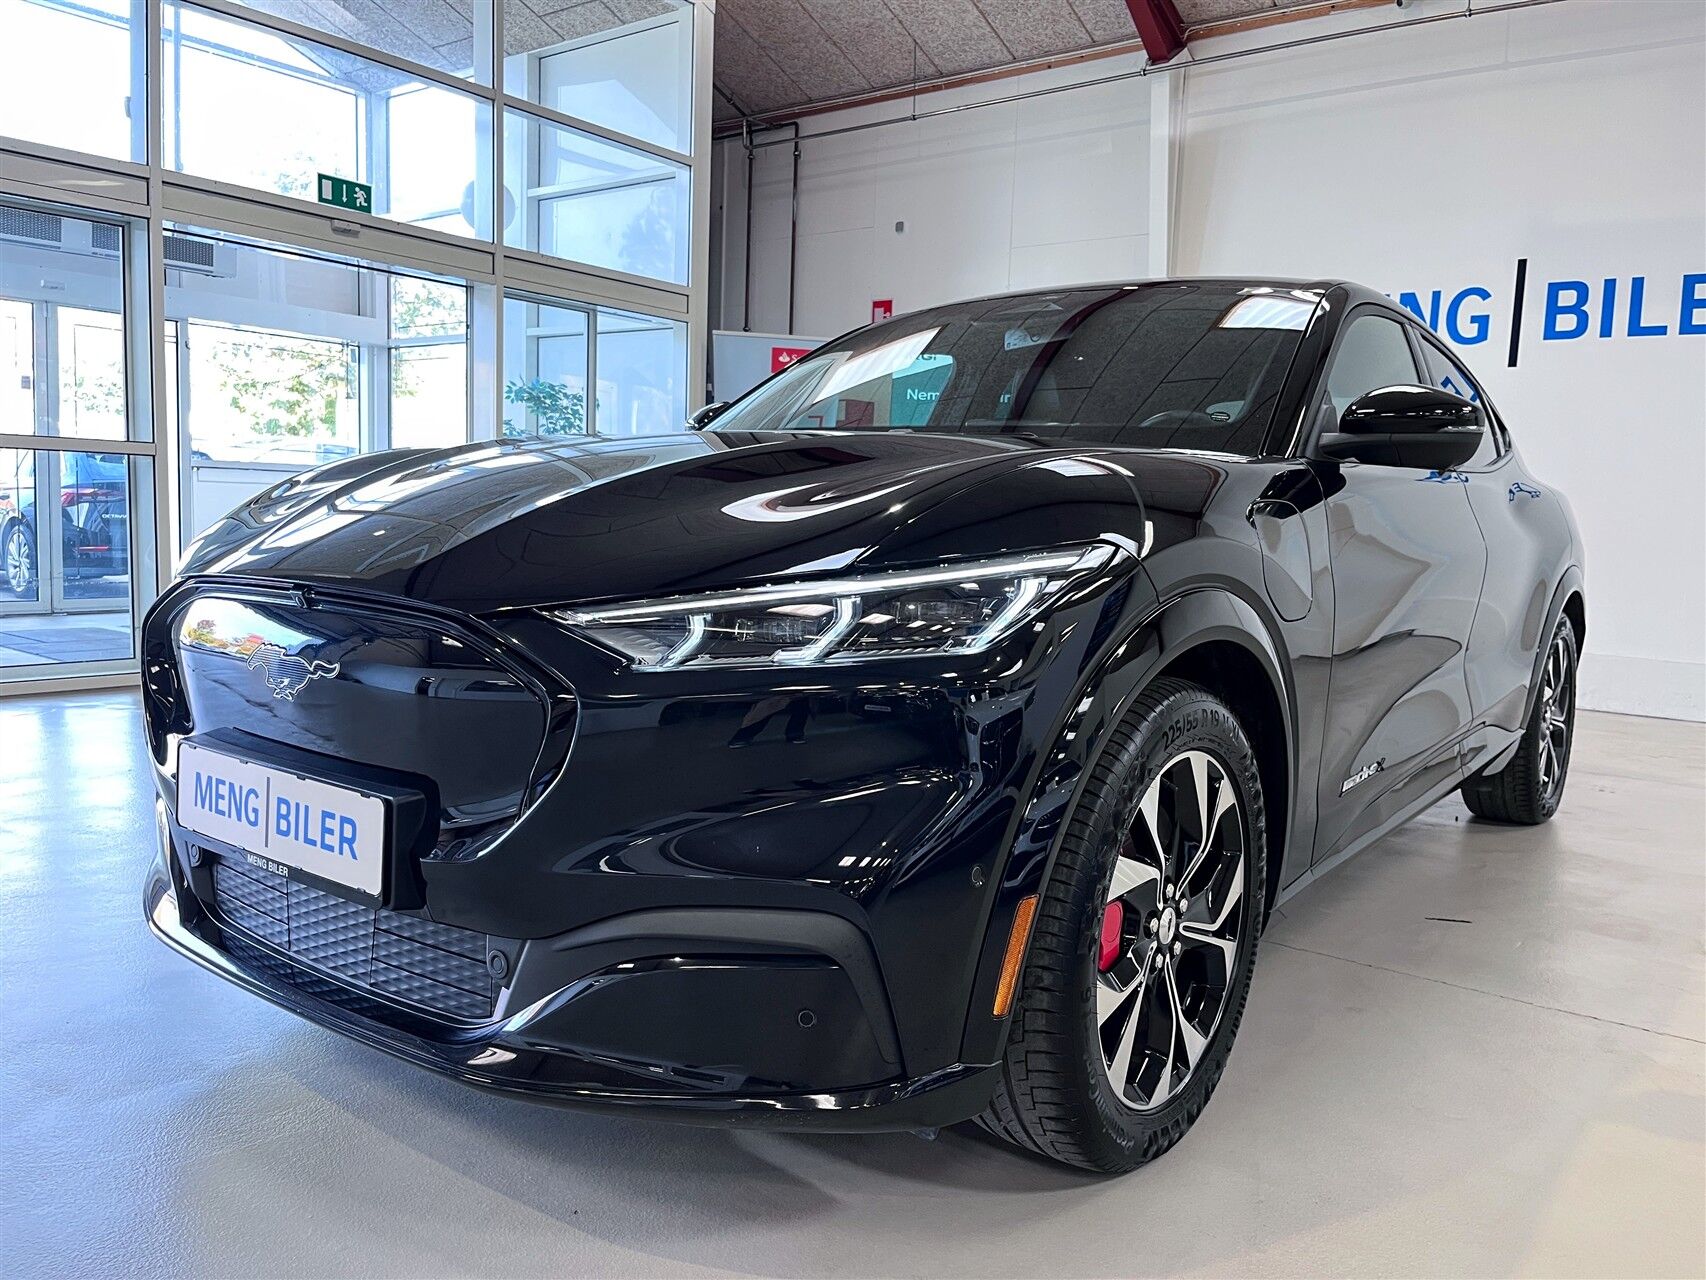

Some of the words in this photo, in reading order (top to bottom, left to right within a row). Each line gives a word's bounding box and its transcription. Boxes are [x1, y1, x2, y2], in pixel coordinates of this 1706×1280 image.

[1386, 287, 1492, 346] NG
[1161, 710, 1199, 752] 225/55
[1210, 709, 1220, 728] 19
[194, 771, 260, 827] MENG
[275, 796, 359, 861] BILER
[247, 853, 267, 869] MENG
[268, 861, 289, 878] BILER
